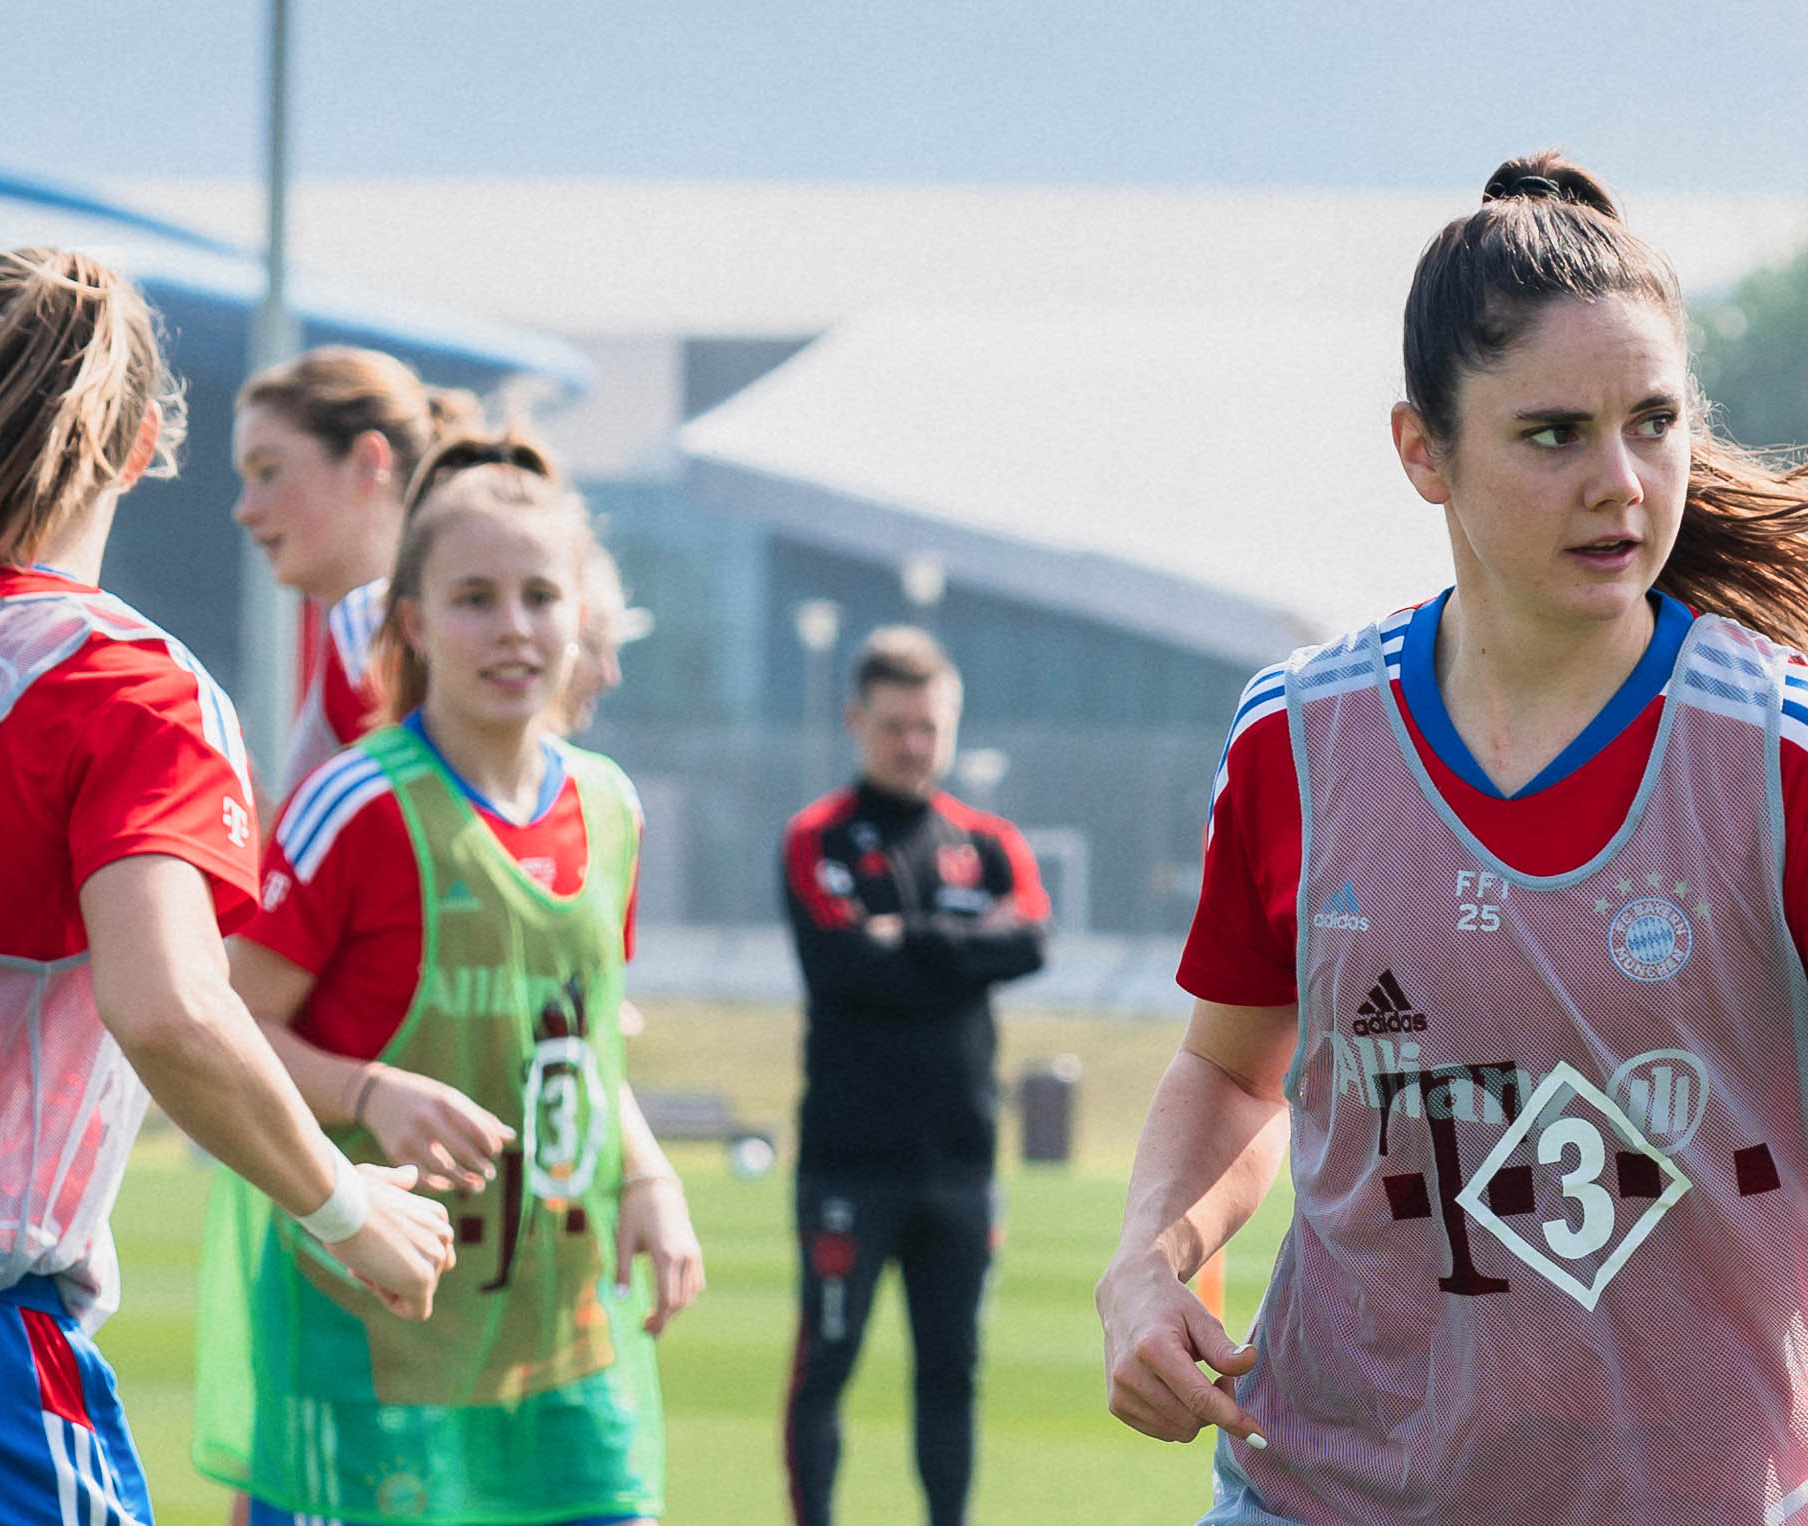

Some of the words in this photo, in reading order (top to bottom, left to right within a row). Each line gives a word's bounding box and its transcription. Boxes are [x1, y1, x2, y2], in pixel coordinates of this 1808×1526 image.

[1312, 911, 1370, 932] adidas
[1457, 903, 1500, 931] 25
[1352, 1011, 1428, 1036] adidas
[542, 1074, 578, 1167] 3
[1537, 1117, 1616, 1260] 3
